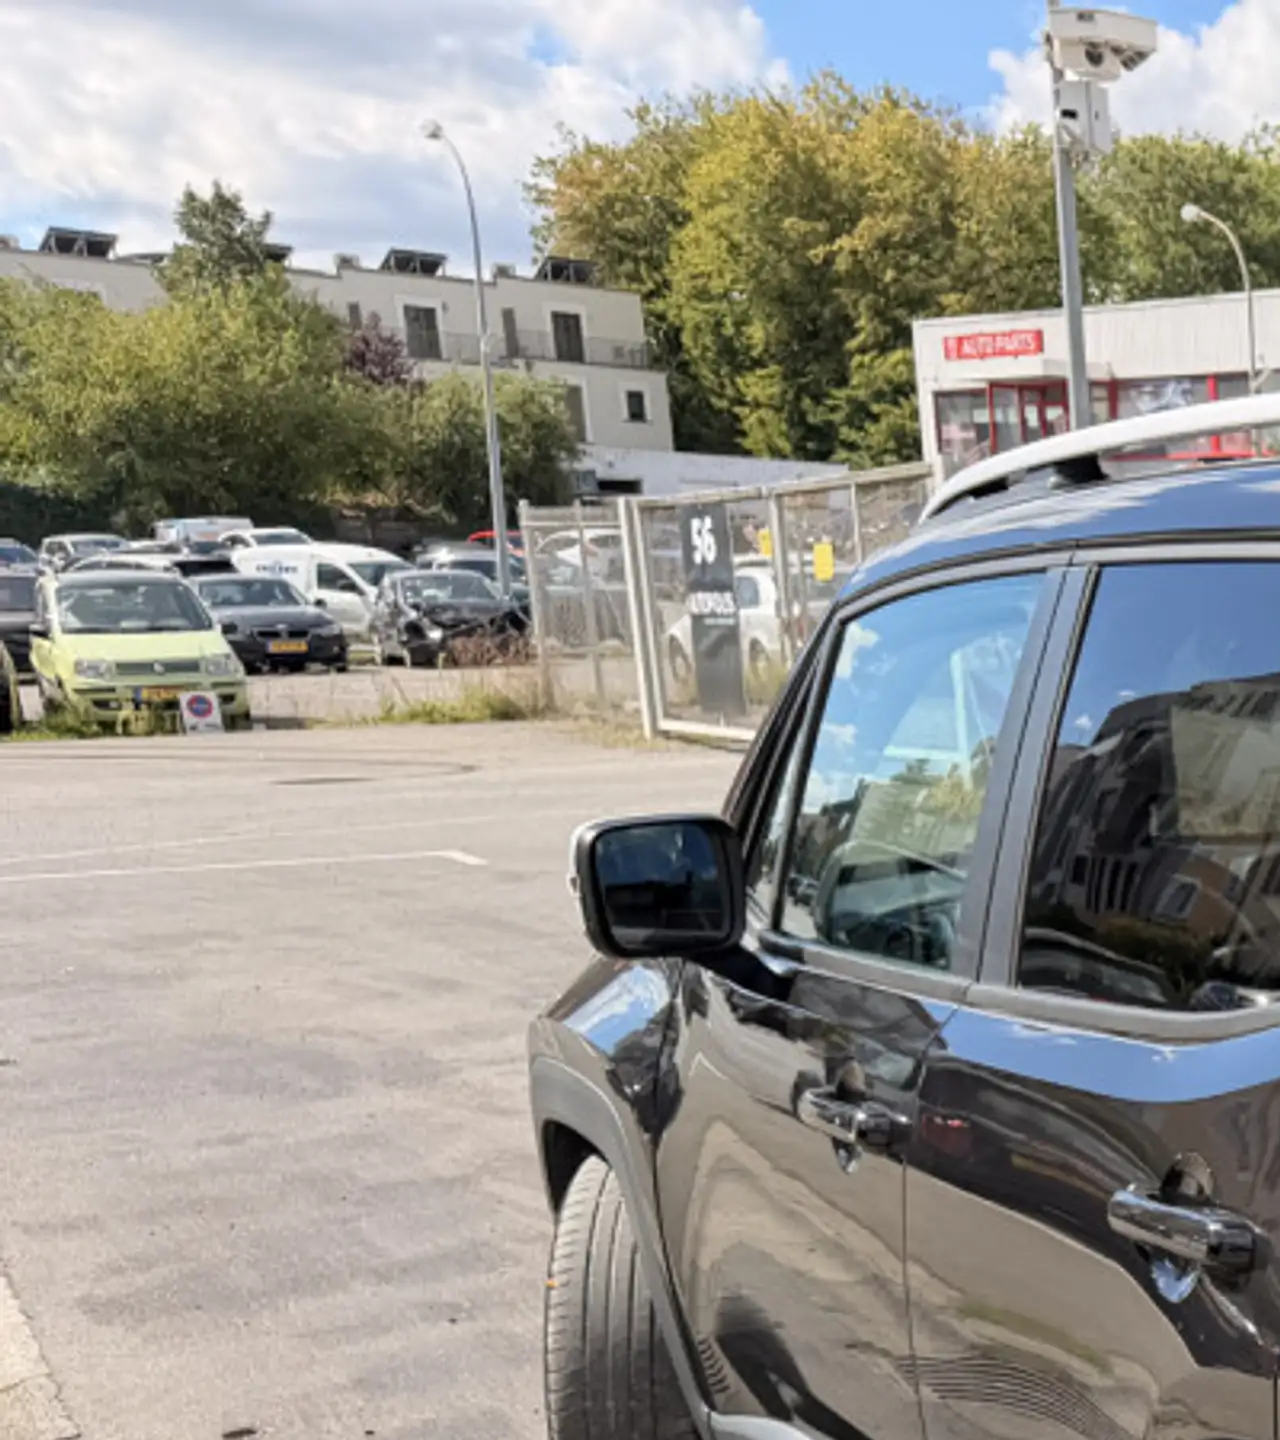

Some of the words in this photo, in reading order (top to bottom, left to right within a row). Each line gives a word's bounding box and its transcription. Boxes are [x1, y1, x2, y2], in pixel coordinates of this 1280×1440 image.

[962, 334, 993, 355] AUTO
[995, 331, 1036, 352] PARTS
[690, 515, 717, 564] 56
